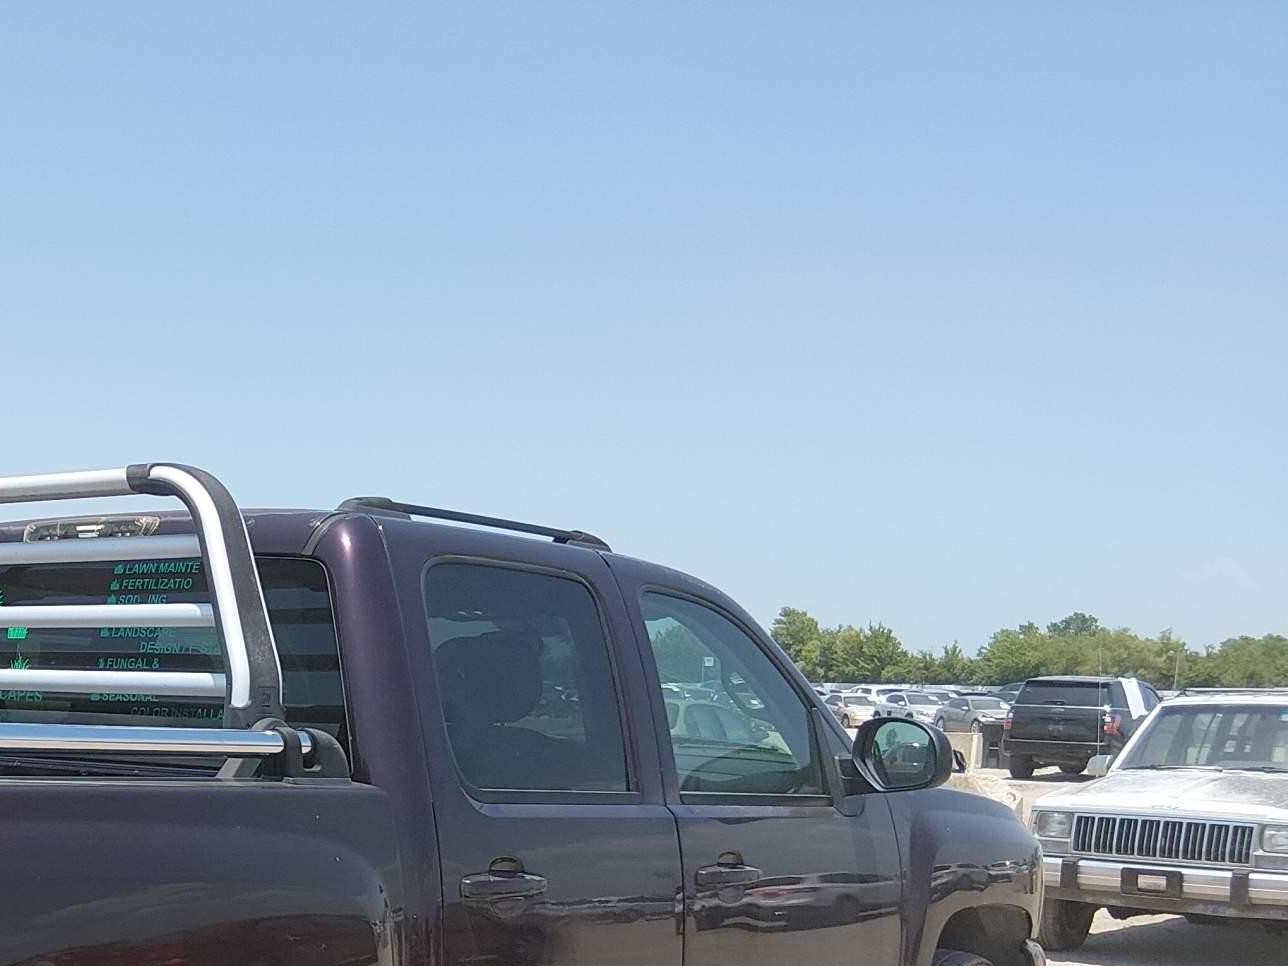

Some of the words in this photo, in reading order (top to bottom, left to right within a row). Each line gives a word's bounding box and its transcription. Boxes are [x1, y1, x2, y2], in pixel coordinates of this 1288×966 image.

[126, 562, 158, 574] LAWN
[106, 657, 149, 669] FUNGAL
[152, 657, 160, 668] &
